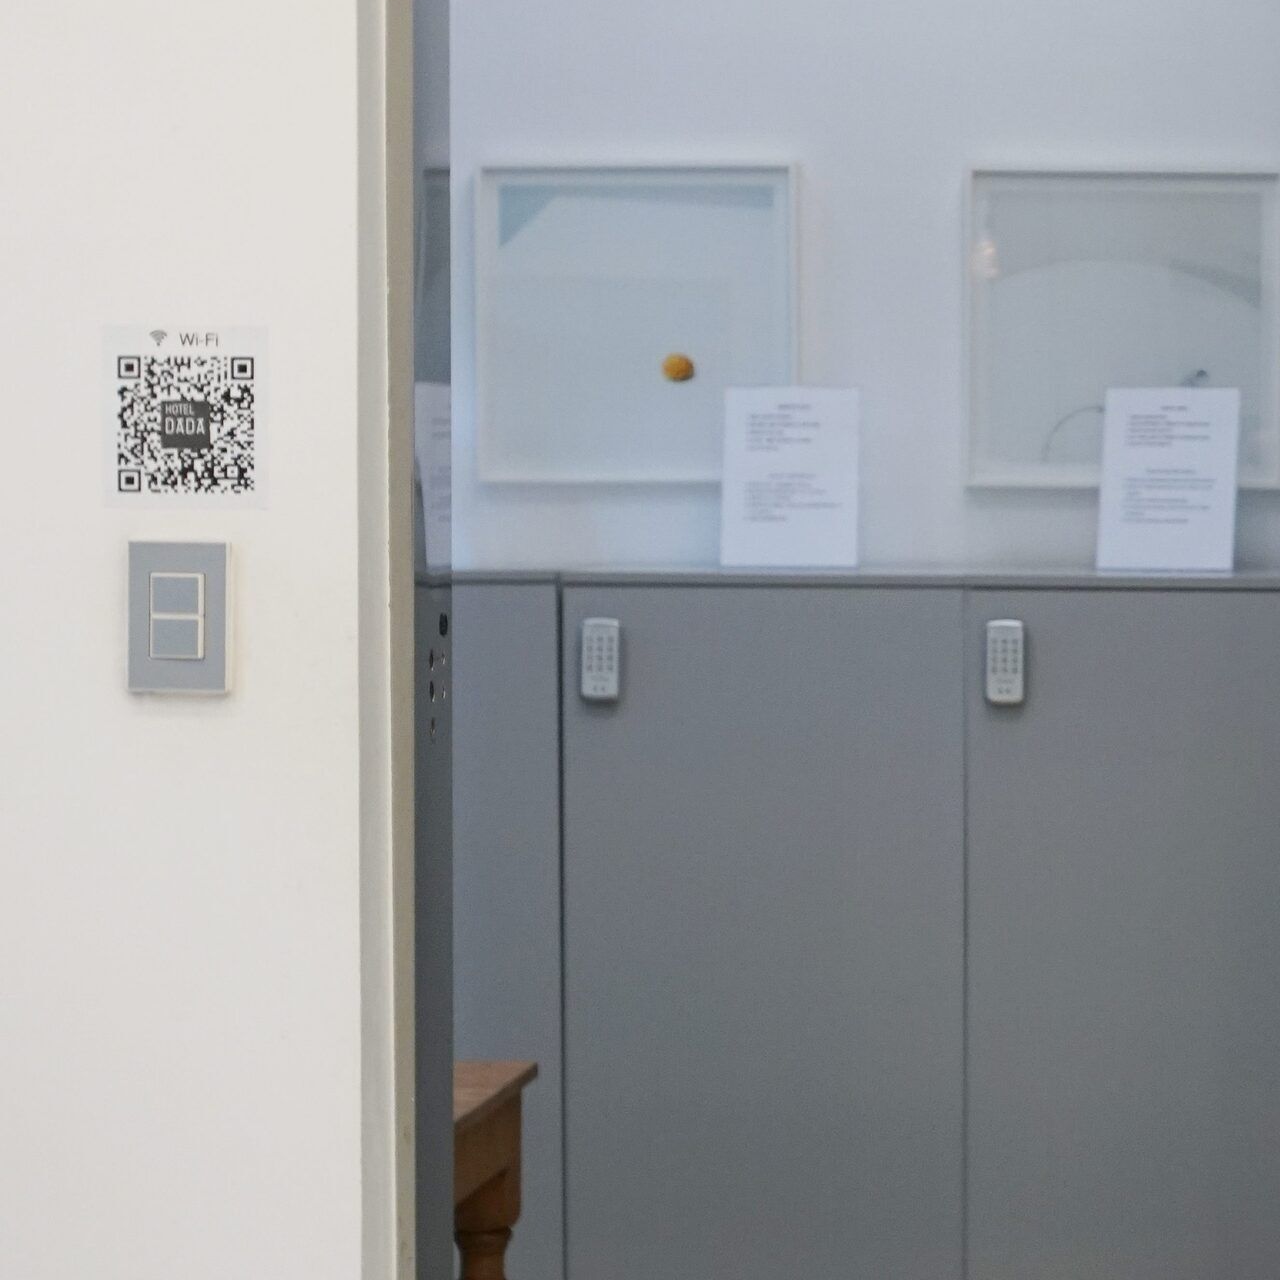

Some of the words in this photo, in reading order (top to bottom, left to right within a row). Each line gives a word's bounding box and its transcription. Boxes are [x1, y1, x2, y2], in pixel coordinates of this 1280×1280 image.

[179, 332, 219, 347] Wi-Fi
[165, 403, 195, 415] HOTEL
[165, 418, 205, 435] DADA
